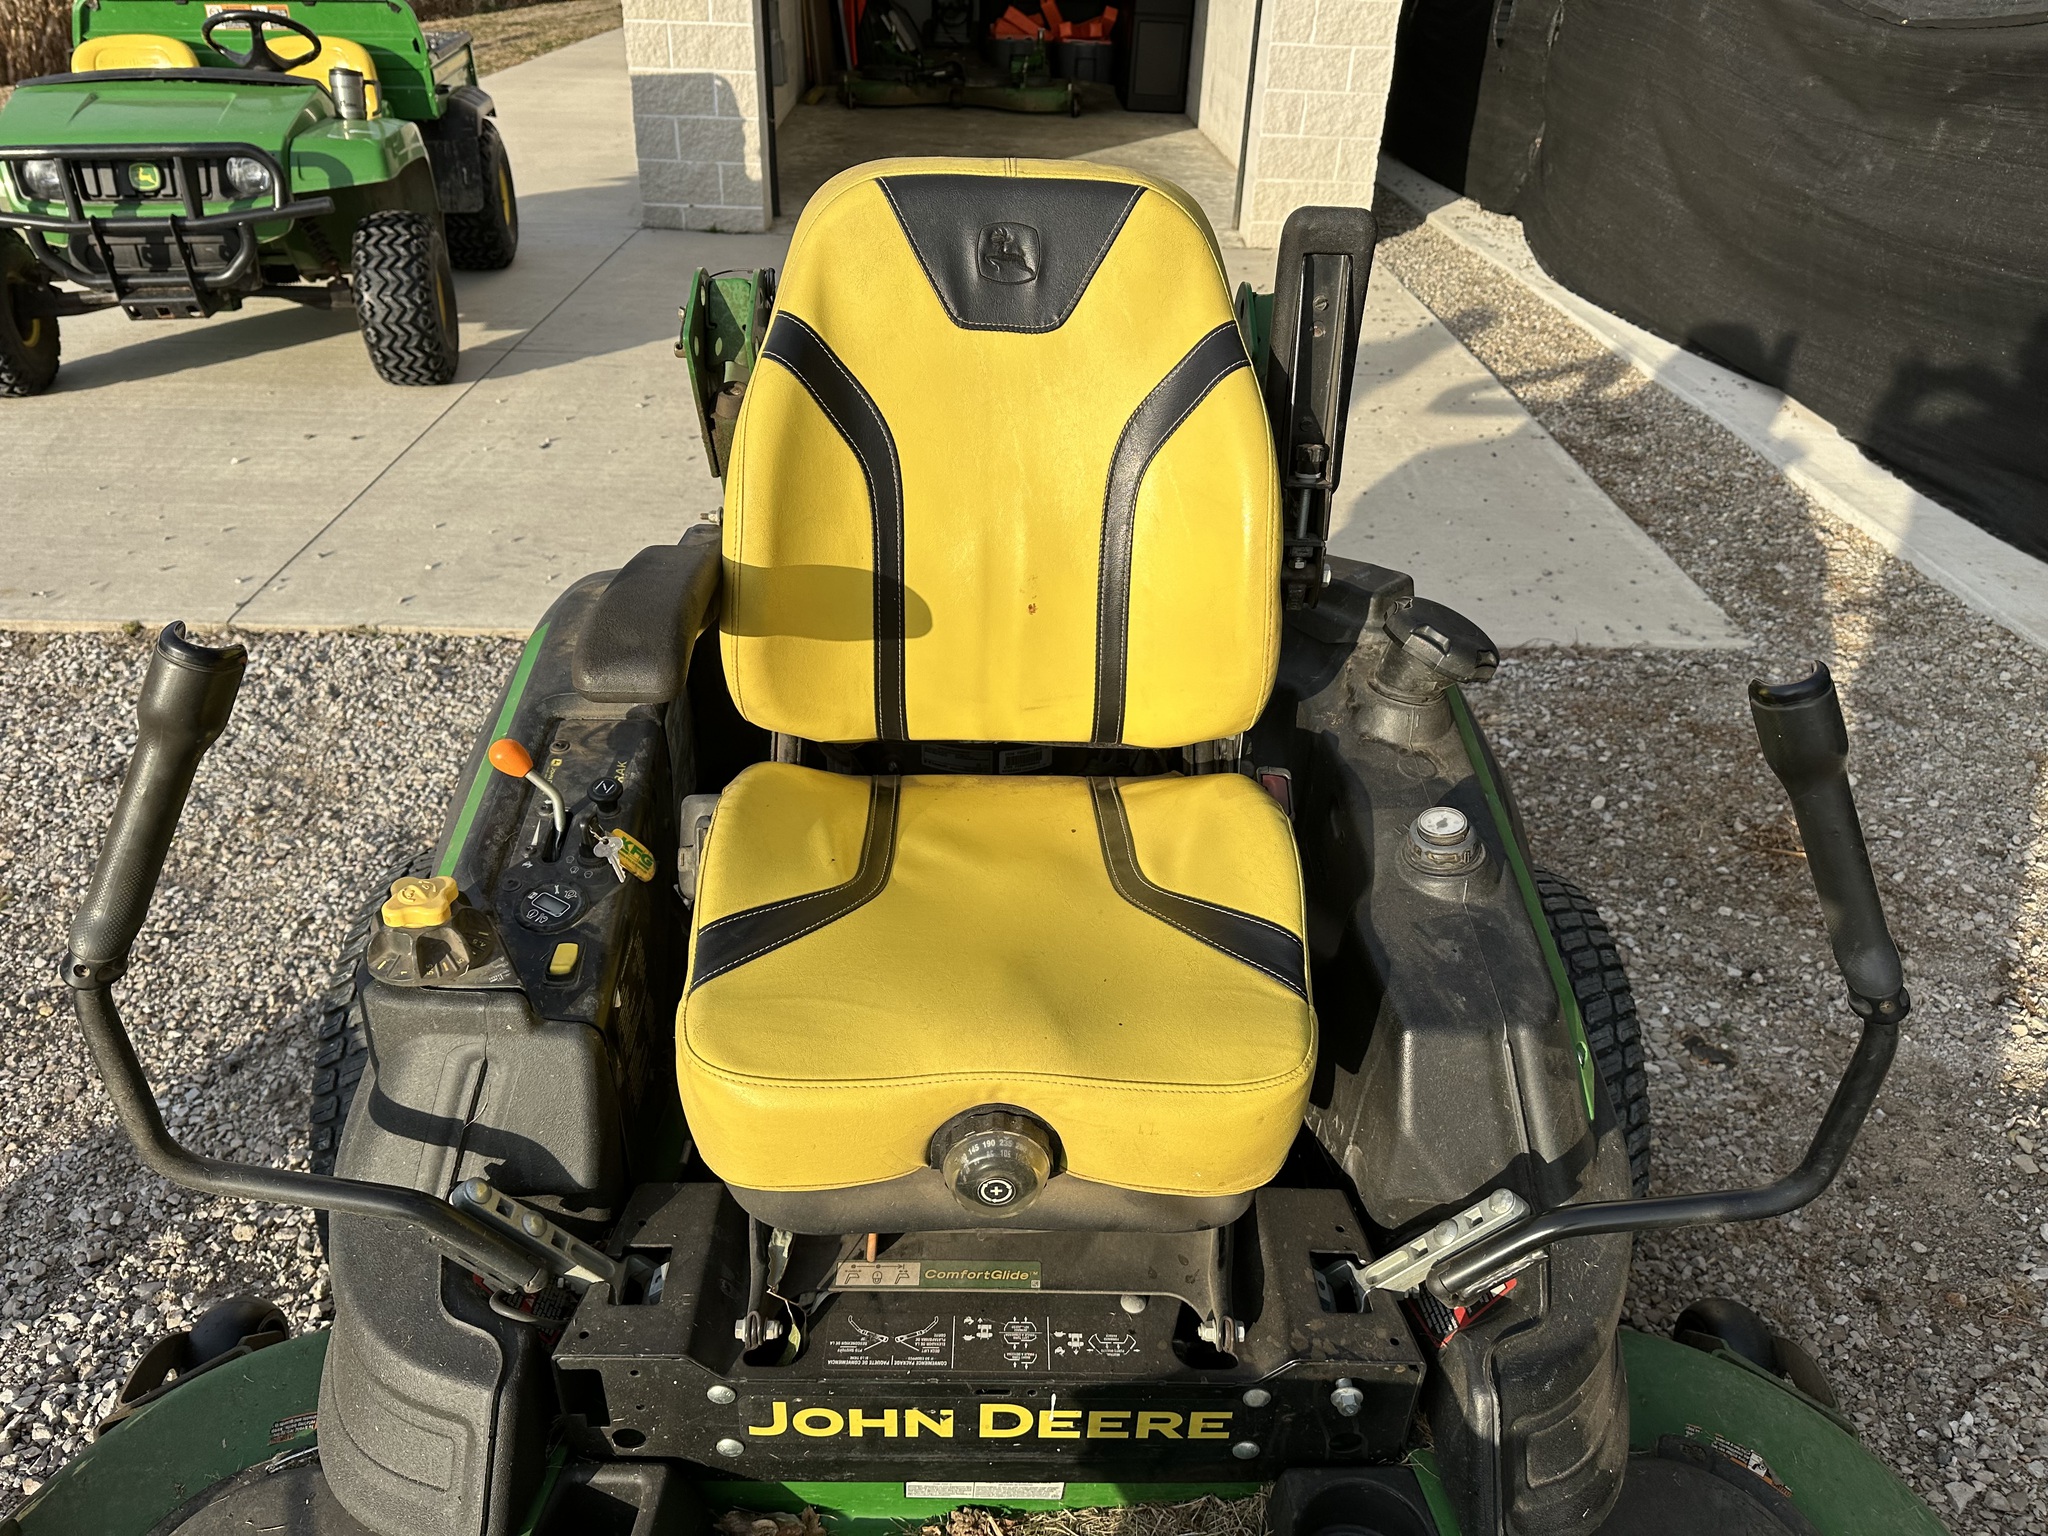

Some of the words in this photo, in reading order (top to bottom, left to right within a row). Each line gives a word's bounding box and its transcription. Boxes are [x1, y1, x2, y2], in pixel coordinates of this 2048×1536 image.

[621, 836, 654, 868] KFG
[968, 1145, 980, 1155] 145
[982, 1140, 996, 1149] 190
[999, 1140, 1013, 1148] 235
[749, 1401, 954, 1437] JOHN
[979, 1403, 1234, 1439] DEERE
